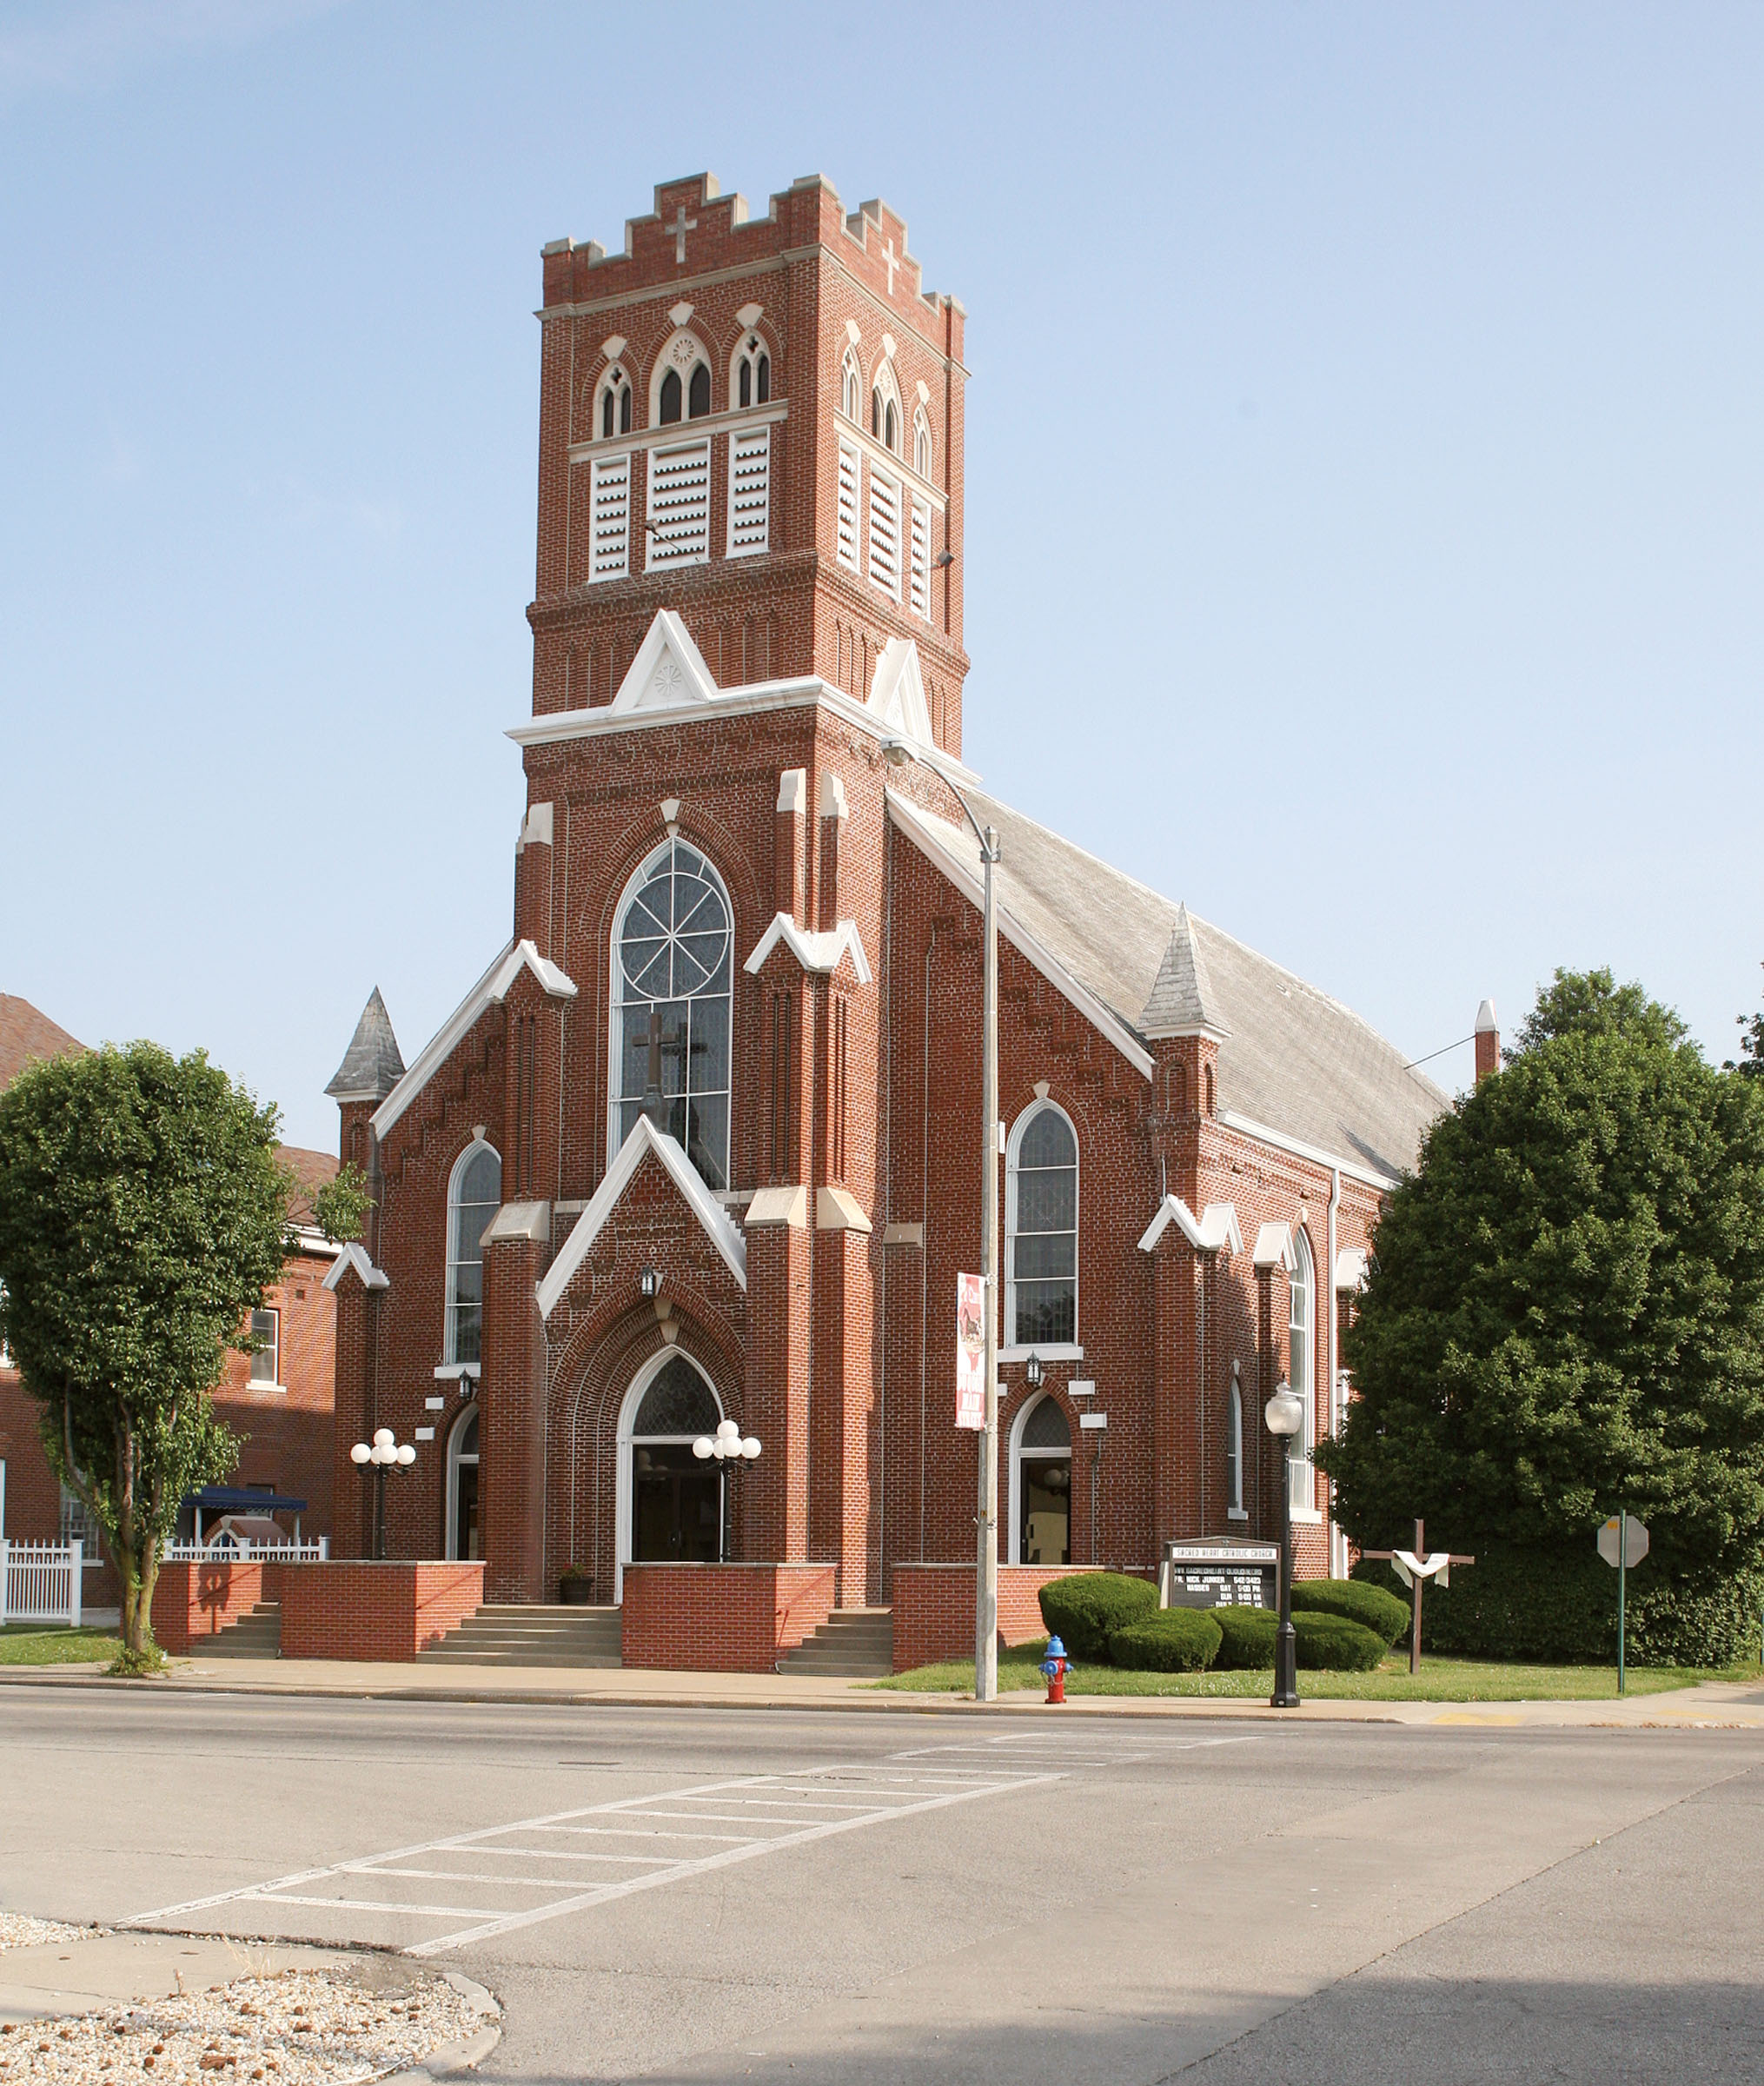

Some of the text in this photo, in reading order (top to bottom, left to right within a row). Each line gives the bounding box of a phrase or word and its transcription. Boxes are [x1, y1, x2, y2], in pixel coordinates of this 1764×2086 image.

[1177, 1548, 1199, 1557] SACRED
[1222, 1549, 1248, 1558] CATHOLIC
[1250, 1549, 1273, 1558] CHURCH
[1186, 1584, 1210, 1592] MASSES
